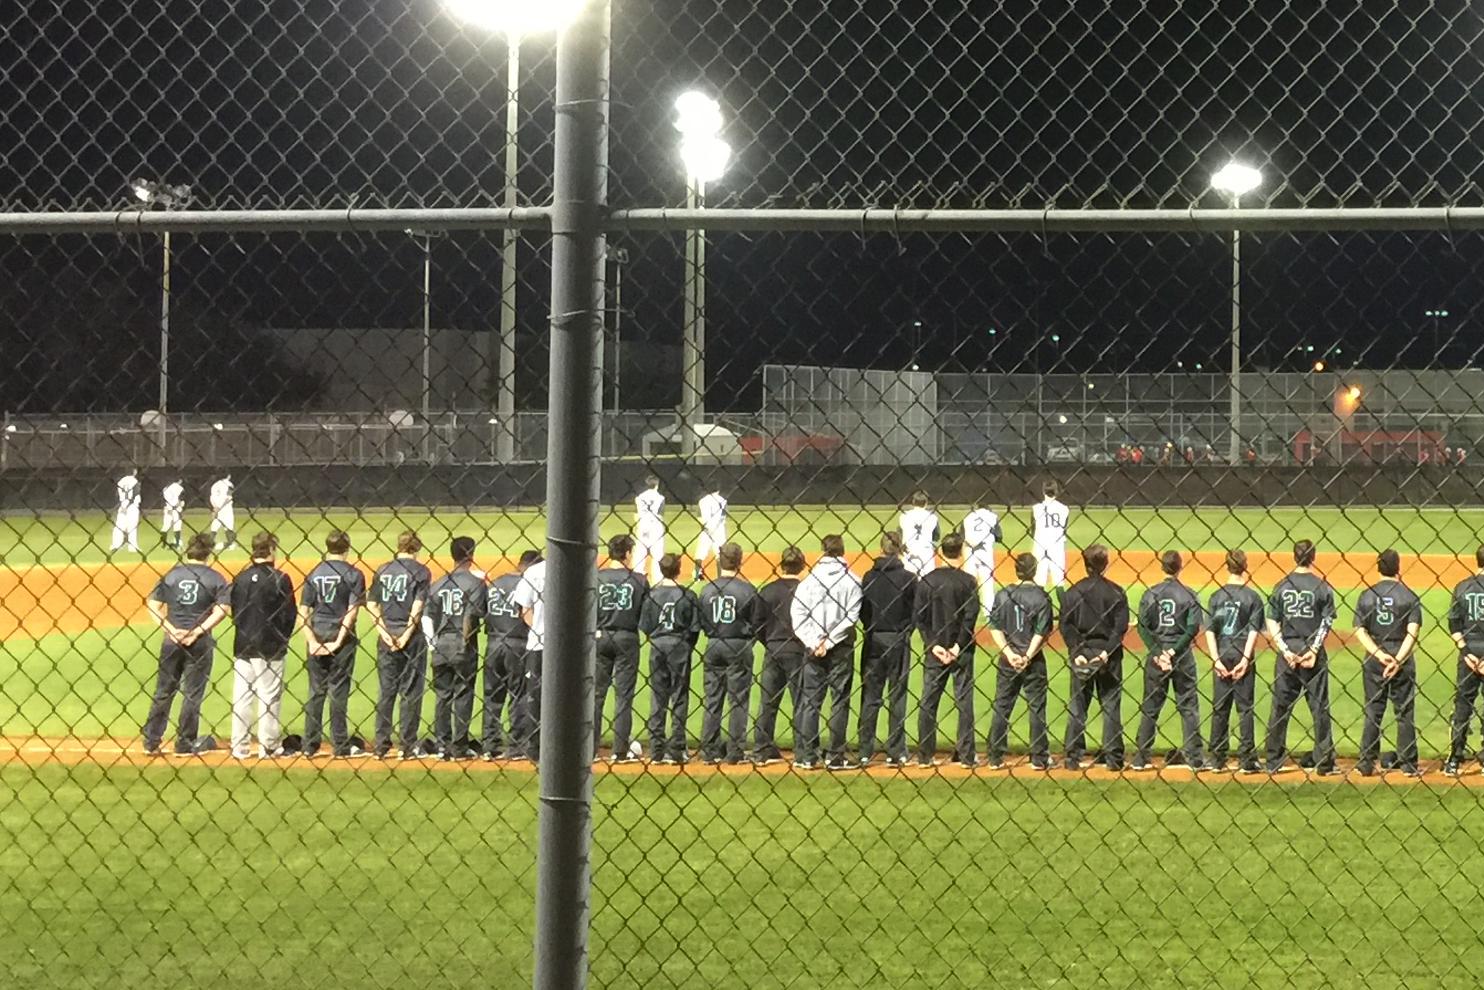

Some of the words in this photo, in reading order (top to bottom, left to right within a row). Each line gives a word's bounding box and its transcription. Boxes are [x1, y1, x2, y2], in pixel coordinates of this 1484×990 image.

[973, 516, 984, 532] 2
[1044, 512, 1060, 528] 10
[178, 580, 199, 605] 3
[313, 575, 341, 604] 17
[380, 574, 408, 602] 14
[599, 583, 634, 610] 23
[488, 587, 519, 618] 24
[659, 602, 676, 630] 4
[710, 595, 736, 624] 18
[1159, 599, 1177, 627] 2
[1282, 589, 1315, 619] 22
[1376, 597, 1394, 625] 5
[1013, 604, 1025, 632] 1
[1223, 600, 1242, 635] 7
